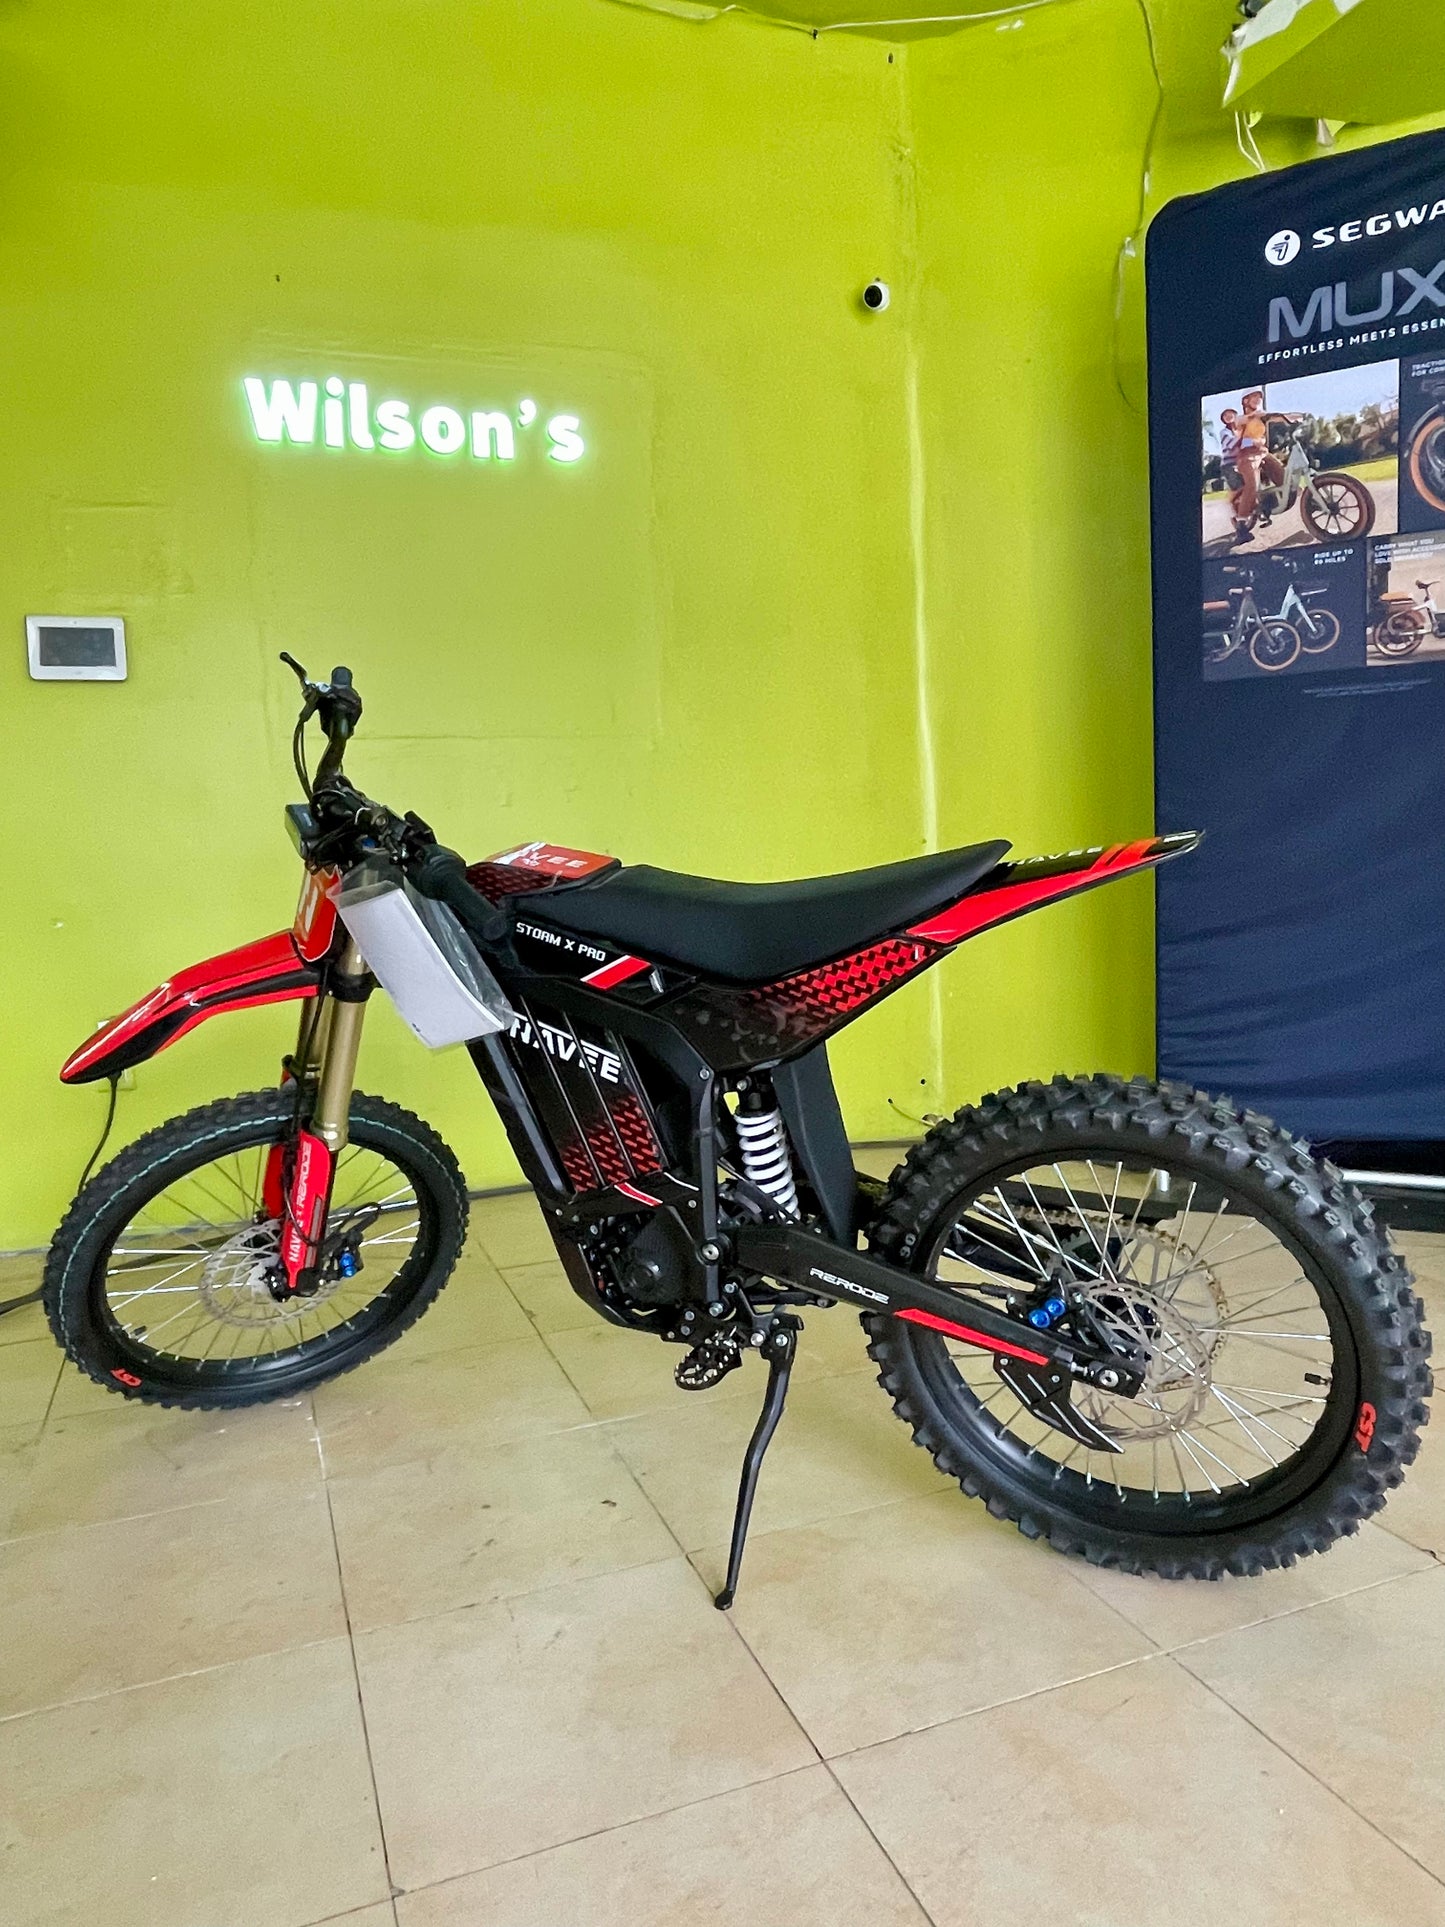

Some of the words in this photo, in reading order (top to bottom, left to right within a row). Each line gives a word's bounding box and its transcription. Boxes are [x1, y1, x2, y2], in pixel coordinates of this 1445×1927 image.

[1258, 338, 1343, 365] EFFORTLESS
[1349, 327, 1396, 346] MEETS
[243, 376, 585, 463] Wilson's
[516, 922, 561, 947] STORM
[564, 939, 575, 951] X
[578, 944, 606, 962] PRO
